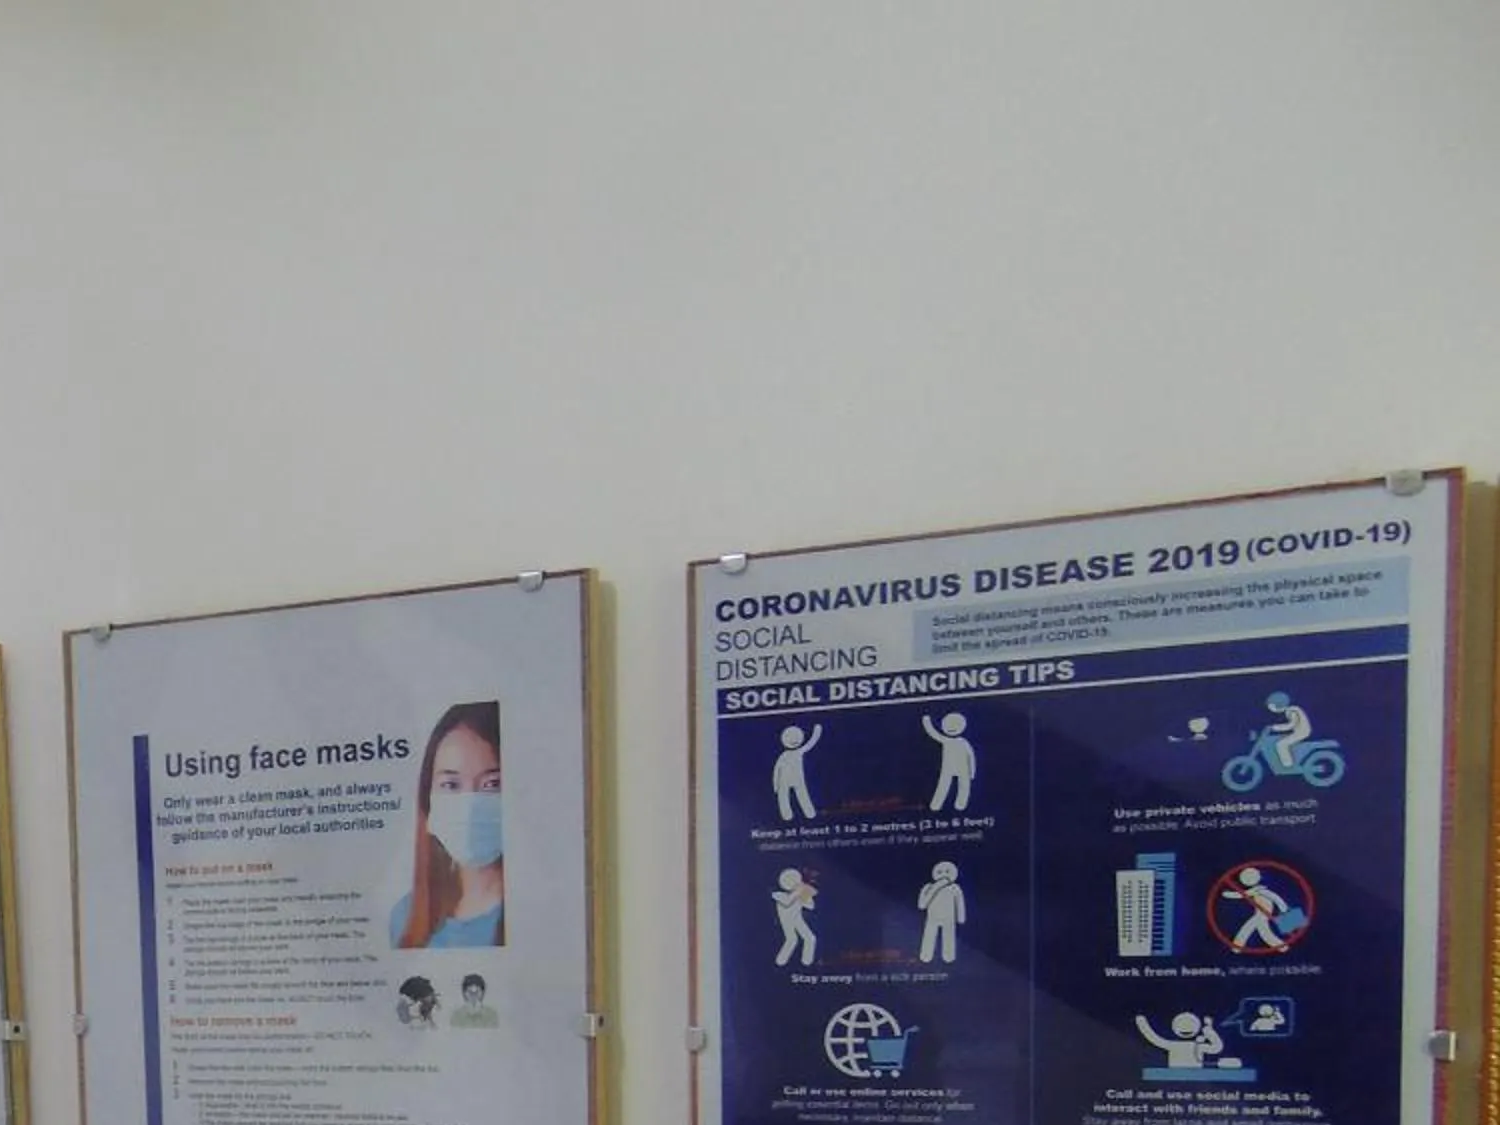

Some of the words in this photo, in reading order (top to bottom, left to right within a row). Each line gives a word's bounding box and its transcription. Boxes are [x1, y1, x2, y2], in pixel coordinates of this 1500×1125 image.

[715, 573, 961, 623] CORONAVIRUS
[975, 552, 1135, 594] DISEASE
[1148, 539, 1240, 573] 2019
[1246, 519, 1412, 562] (COVID-19)
[932, 612, 970, 626] Social
[973, 606, 1038, 622] distancing
[1041, 602, 1083, 615] means
[1171, 585, 1243, 602] increasing
[1247, 581, 1270, 593] the
[1274, 575, 1334, 591] physical
[1338, 569, 1383, 584] space
[931, 627, 984, 641] between
[987, 621, 1038, 637] yourself
[1041, 618, 1065, 630] and
[1118, 607, 1158, 622] These
[1161, 606, 1183, 617] are
[1186, 598, 1254, 613] measures
[1257, 596, 1285, 609] you
[1290, 592, 1316, 604] can
[1319, 588, 1350, 600] take
[1353, 586, 1370, 597] to
[715, 623, 812, 653] SOCIAL
[961, 639, 981, 651] the
[984, 635, 1027, 650] spread
[1031, 632, 1043, 643] of
[717, 645, 877, 681] DISTANCING
[726, 684, 820, 711] SOCIAL
[829, 666, 1000, 702] DISTANCING
[1008, 659, 1075, 685] TIPS
[165, 752, 241, 779] Using
[251, 745, 307, 770] face
[317, 733, 411, 766] masks
[163, 796, 192, 811] Only
[195, 794, 224, 807] wear
[227, 794, 236, 805] a
[239, 790, 273, 804] clean
[317, 783, 342, 797] and
[345, 781, 392, 796] always
[156, 812, 193, 827] follow
[195, 811, 215, 824] the
[219, 802, 315, 822] manufacturer's
[1114, 807, 1141, 819] Use
[1199, 801, 1261, 815] vehicles
[171, 827, 229, 845] guidance
[231, 824, 245, 839] of
[247, 824, 276, 840] your
[278, 820, 311, 836] local
[313, 818, 385, 833] authorities
[751, 828, 781, 840] Keep
[784, 827, 797, 837] at
[799, 825, 829, 836] least
[844, 824, 858, 834] to
[791, 972, 817, 985] Stay
[1105, 966, 1140, 977] Work
[1144, 965, 1177, 977] from
[783, 1085, 807, 1096] Call
[891, 1087, 945, 1098] services
[1105, 1088, 1133, 1100] Call
[1136, 1089, 1163, 1100] and
[1167, 1090, 1192, 1101] use
[1196, 1089, 1240, 1101] social
[1243, 1090, 1290, 1102] media
[1294, 1092, 1312, 1102] to
[1153, 1103, 1184, 1114] with
[1187, 1103, 1239, 1115] friends
[1242, 1104, 1270, 1116] and
